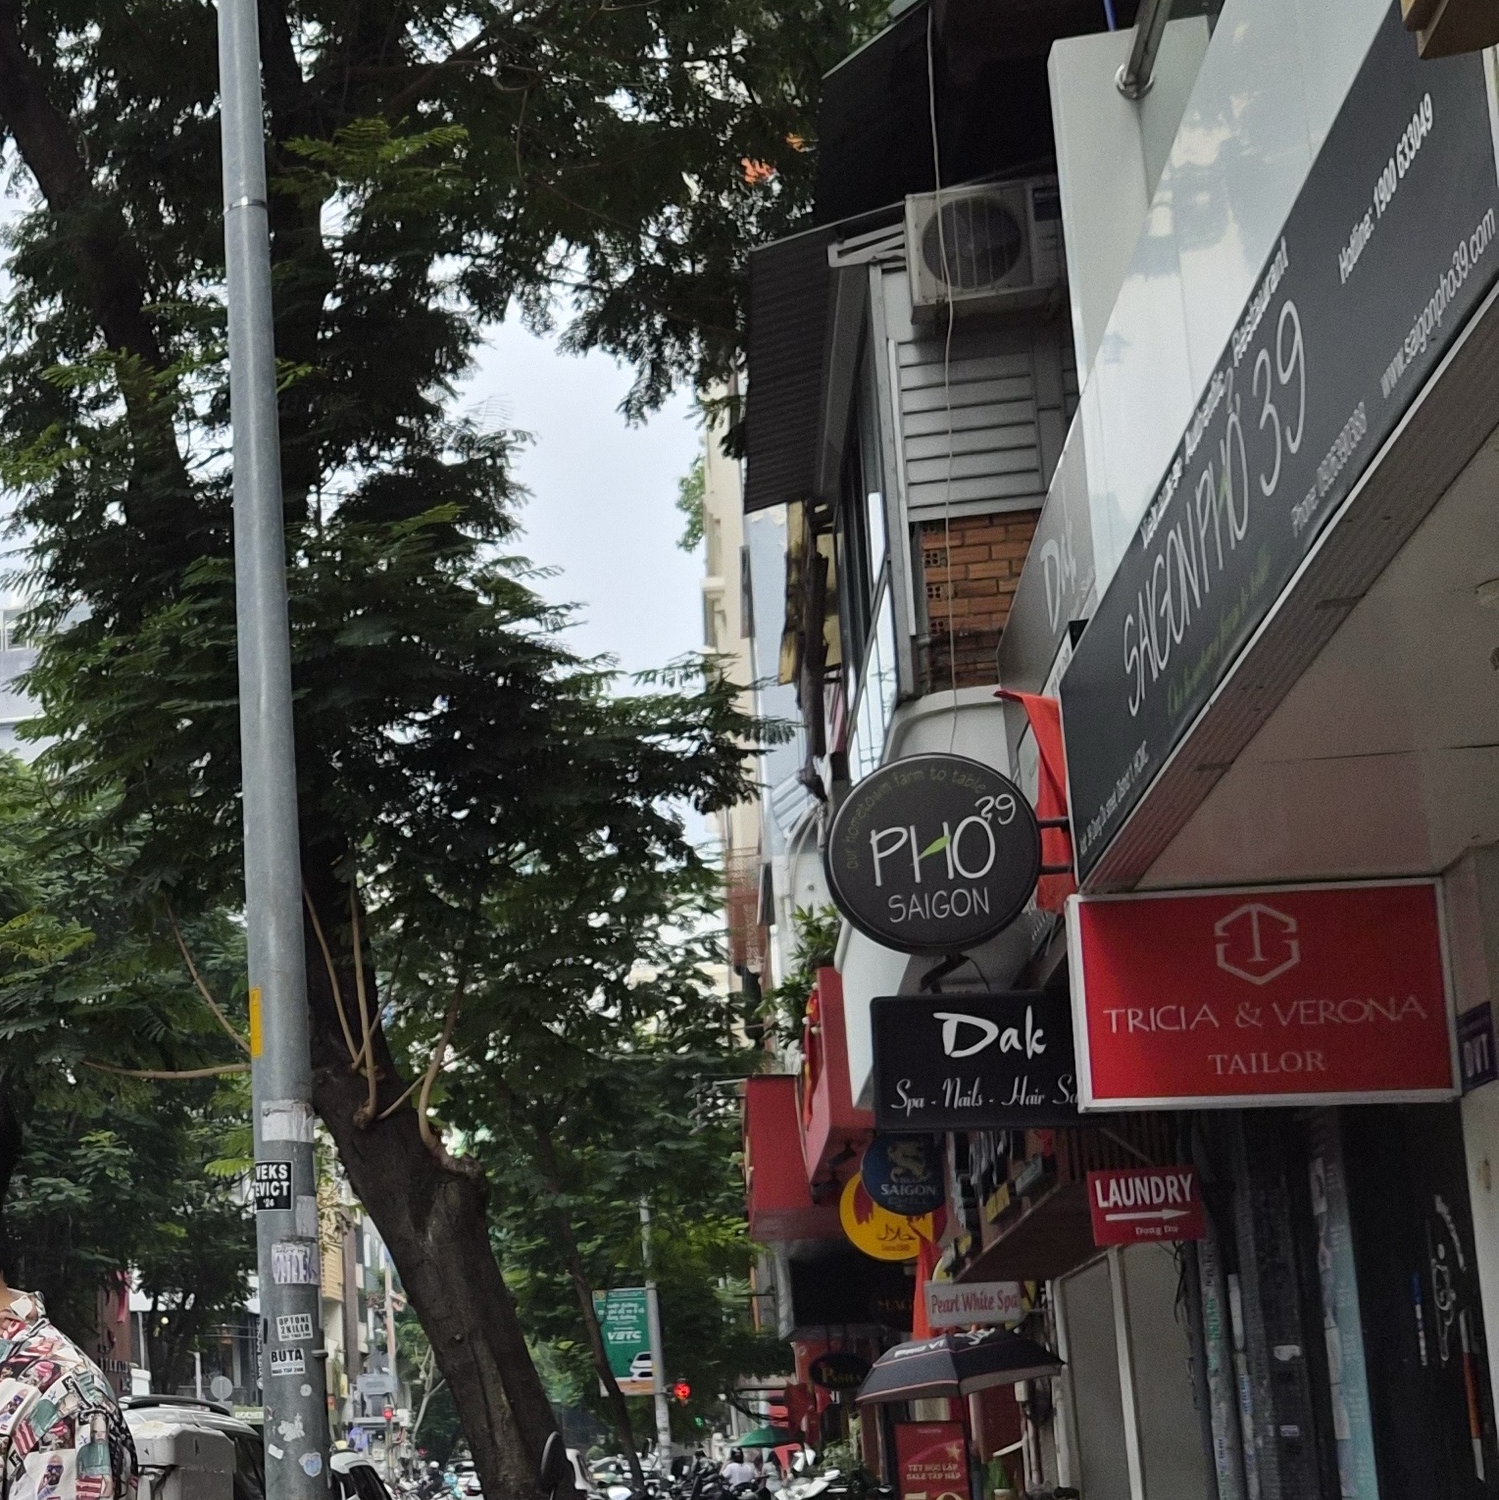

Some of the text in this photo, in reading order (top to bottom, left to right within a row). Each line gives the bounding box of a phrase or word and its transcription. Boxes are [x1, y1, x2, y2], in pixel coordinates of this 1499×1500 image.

[1373, 156, 1397, 219] 1900
[1396, 92, 1433, 179] 633049
[1379, 207, 1496, 399] www.saigonpho39.com
[1253, 299, 1306, 497] 39
[888, 886, 990, 924] SAIGON
[932, 1004, 1047, 1060] Dak
[1102, 995, 1428, 1034] TRICIA & VERONA
[1207, 1050, 1327, 1076] TAILOR
[890, 1078, 924, 1117] Spa
[942, 1076, 982, 1109] Nails
[1000, 1075, 1045, 1107] Hair
[881, 1183, 936, 1196] SAIGON
[1095, 1172, 1193, 1208] LAUNDRY
[931, 1293, 959, 1315] Pearl
[961, 1291, 994, 1313] White
[997, 1289, 1018, 1314] Spa
[271, 1348, 303, 1363] BUTA
